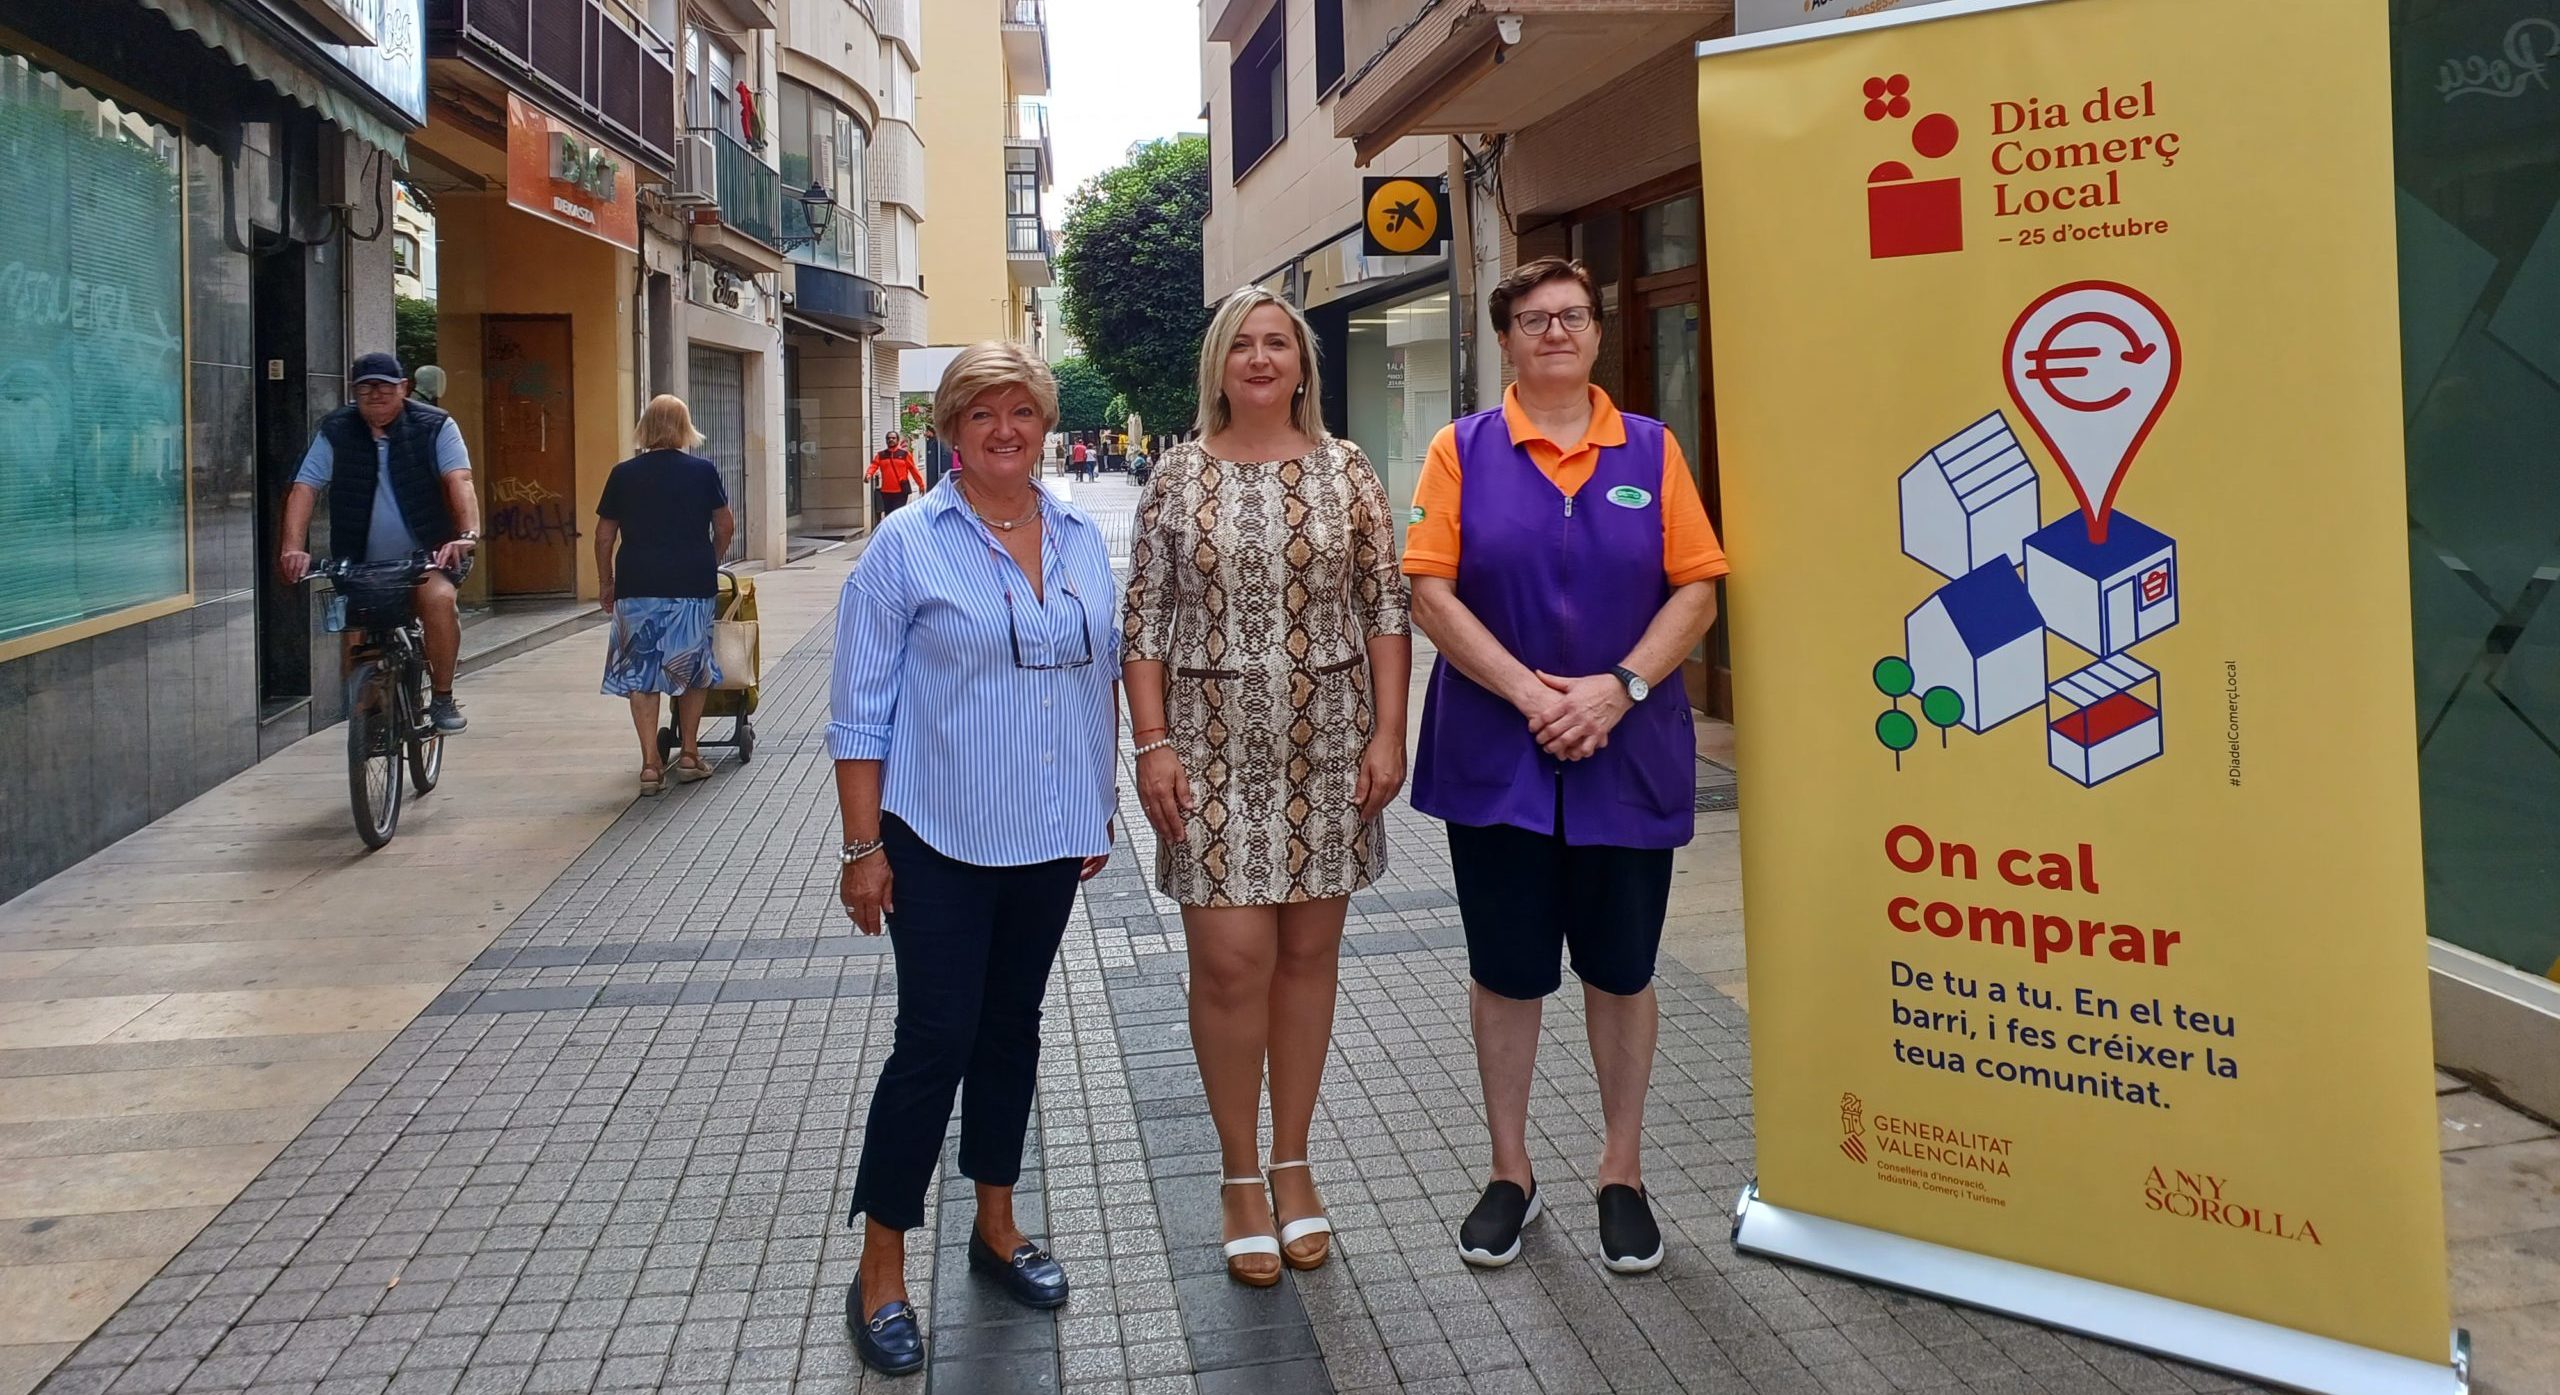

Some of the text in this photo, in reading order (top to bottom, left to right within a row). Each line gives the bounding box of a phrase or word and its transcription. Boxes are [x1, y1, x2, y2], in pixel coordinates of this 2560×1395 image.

[1990, 81, 2156, 135] Dia del
[1991, 132, 2180, 176] Comerç
[1993, 169, 2121, 216] Local
[2018, 228, 2046, 246] 25
[2052, 217, 2169, 243] d’octubre
[2224, 660, 2241, 787] #DiadelComerçLocal
[1885, 824, 2099, 894] On cal
[1887, 896, 2181, 966] comprar
[1891, 961, 2235, 1037] De tu a tu. En el teu
[1892, 999, 2238, 1079] barri, i fes créixer la
[1893, 1038, 2171, 1109] teua comunitat.
[1873, 1115, 2013, 1156] GENERALITAT
[1876, 1135, 2011, 1178] VALENCIANA
[1877, 1160, 1928, 1179] Conselleria
[1878, 1172, 1920, 1190] Indústria,
[1922, 1181, 1959, 1199] Comerç
[1967, 1191, 2006, 1207] Turisme
[2144, 1165, 2227, 1200] ANY
